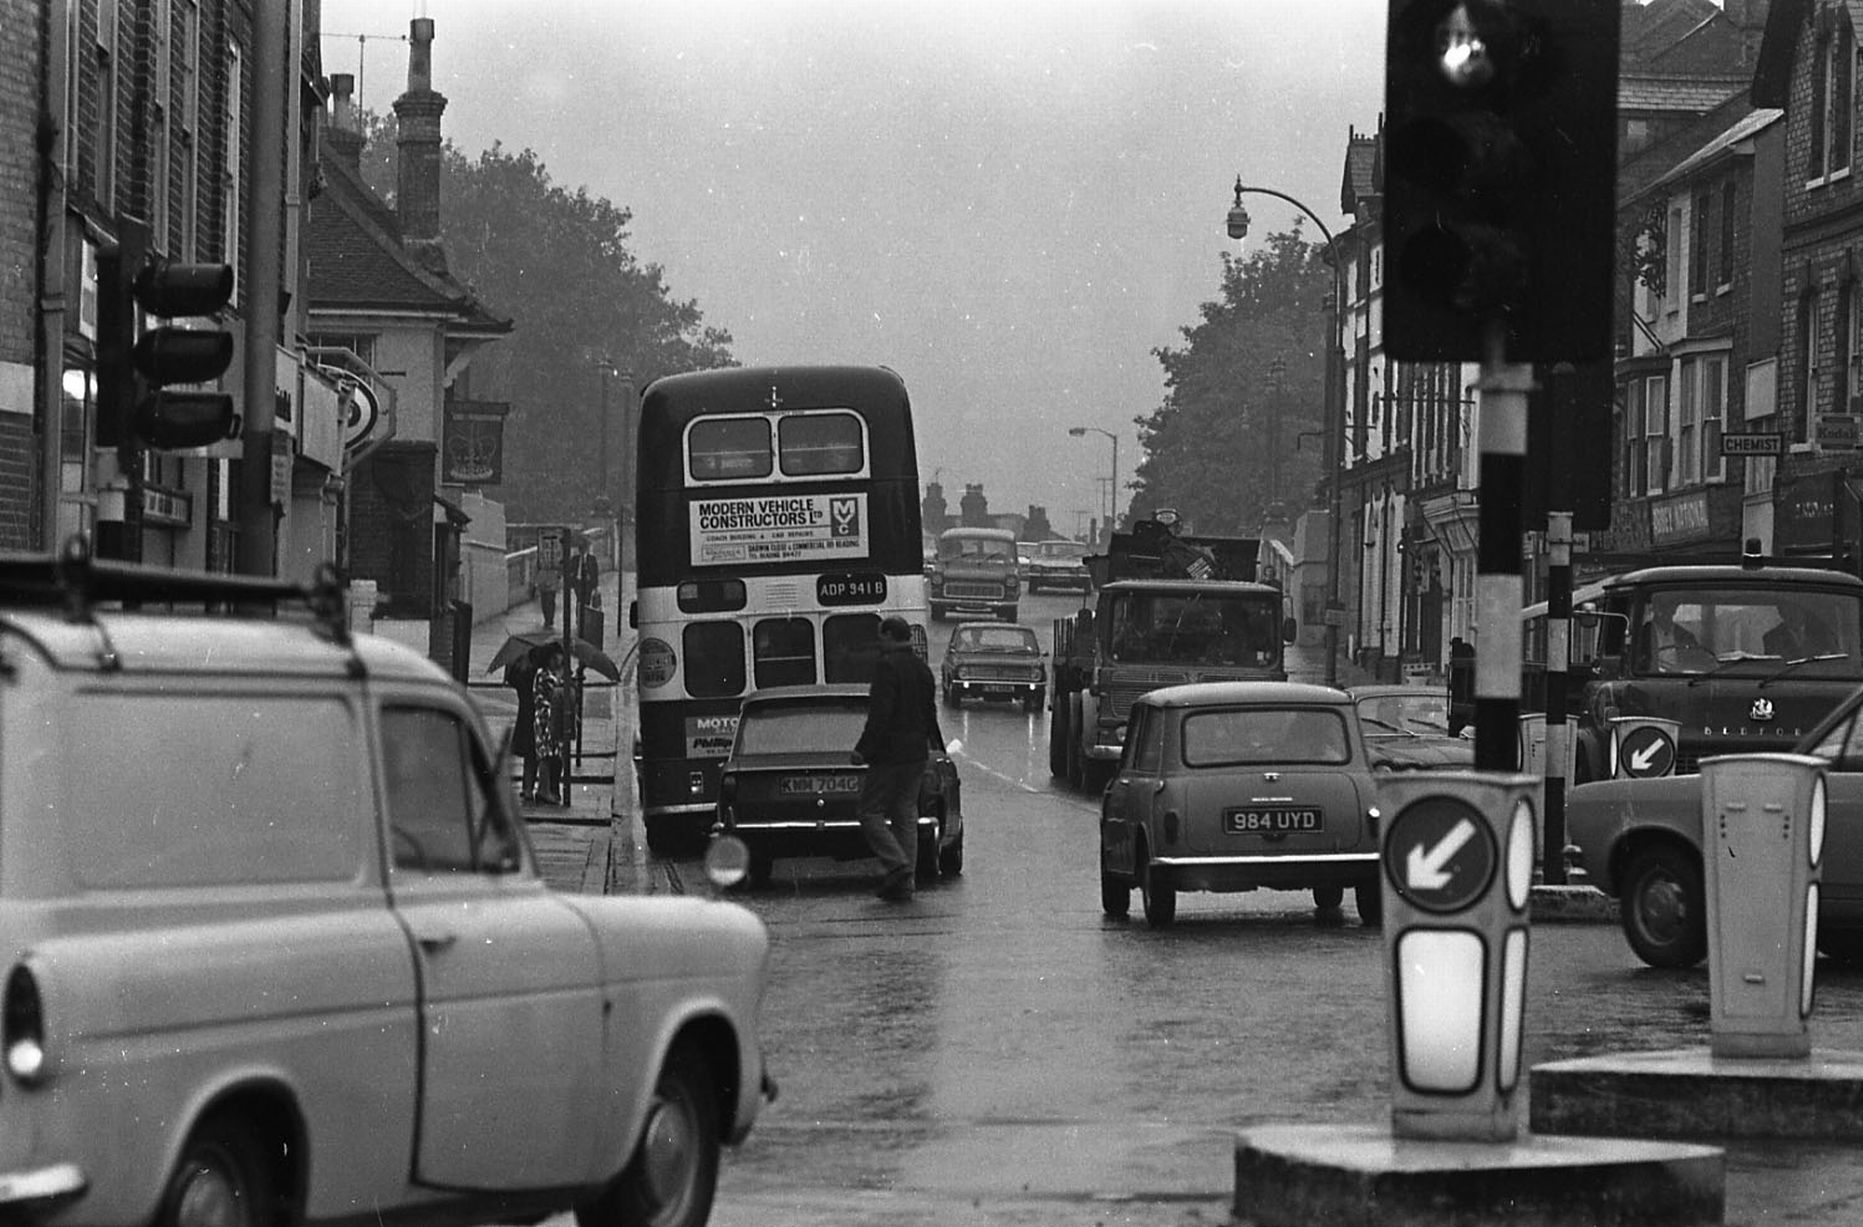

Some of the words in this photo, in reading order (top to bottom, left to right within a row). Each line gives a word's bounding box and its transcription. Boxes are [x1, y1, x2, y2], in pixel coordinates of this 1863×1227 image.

[1726, 438, 1778, 451] CHEMIST
[699, 502, 754, 516] MODERN
[758, 499, 814, 513] VEHICLE
[700, 513, 807, 529] CONSTRUCTORS
[793, 542, 825, 550] COMMERCIAL
[836, 540, 859, 548] READING
[820, 583, 846, 597] ADP
[849, 582, 872, 596] 941
[875, 581, 884, 594] B
[697, 717, 739, 729] MOTO
[1704, 726, 1801, 736] BEDFOR
[1234, 812, 1271, 829] 984
[1277, 811, 1315, 828] UYD
